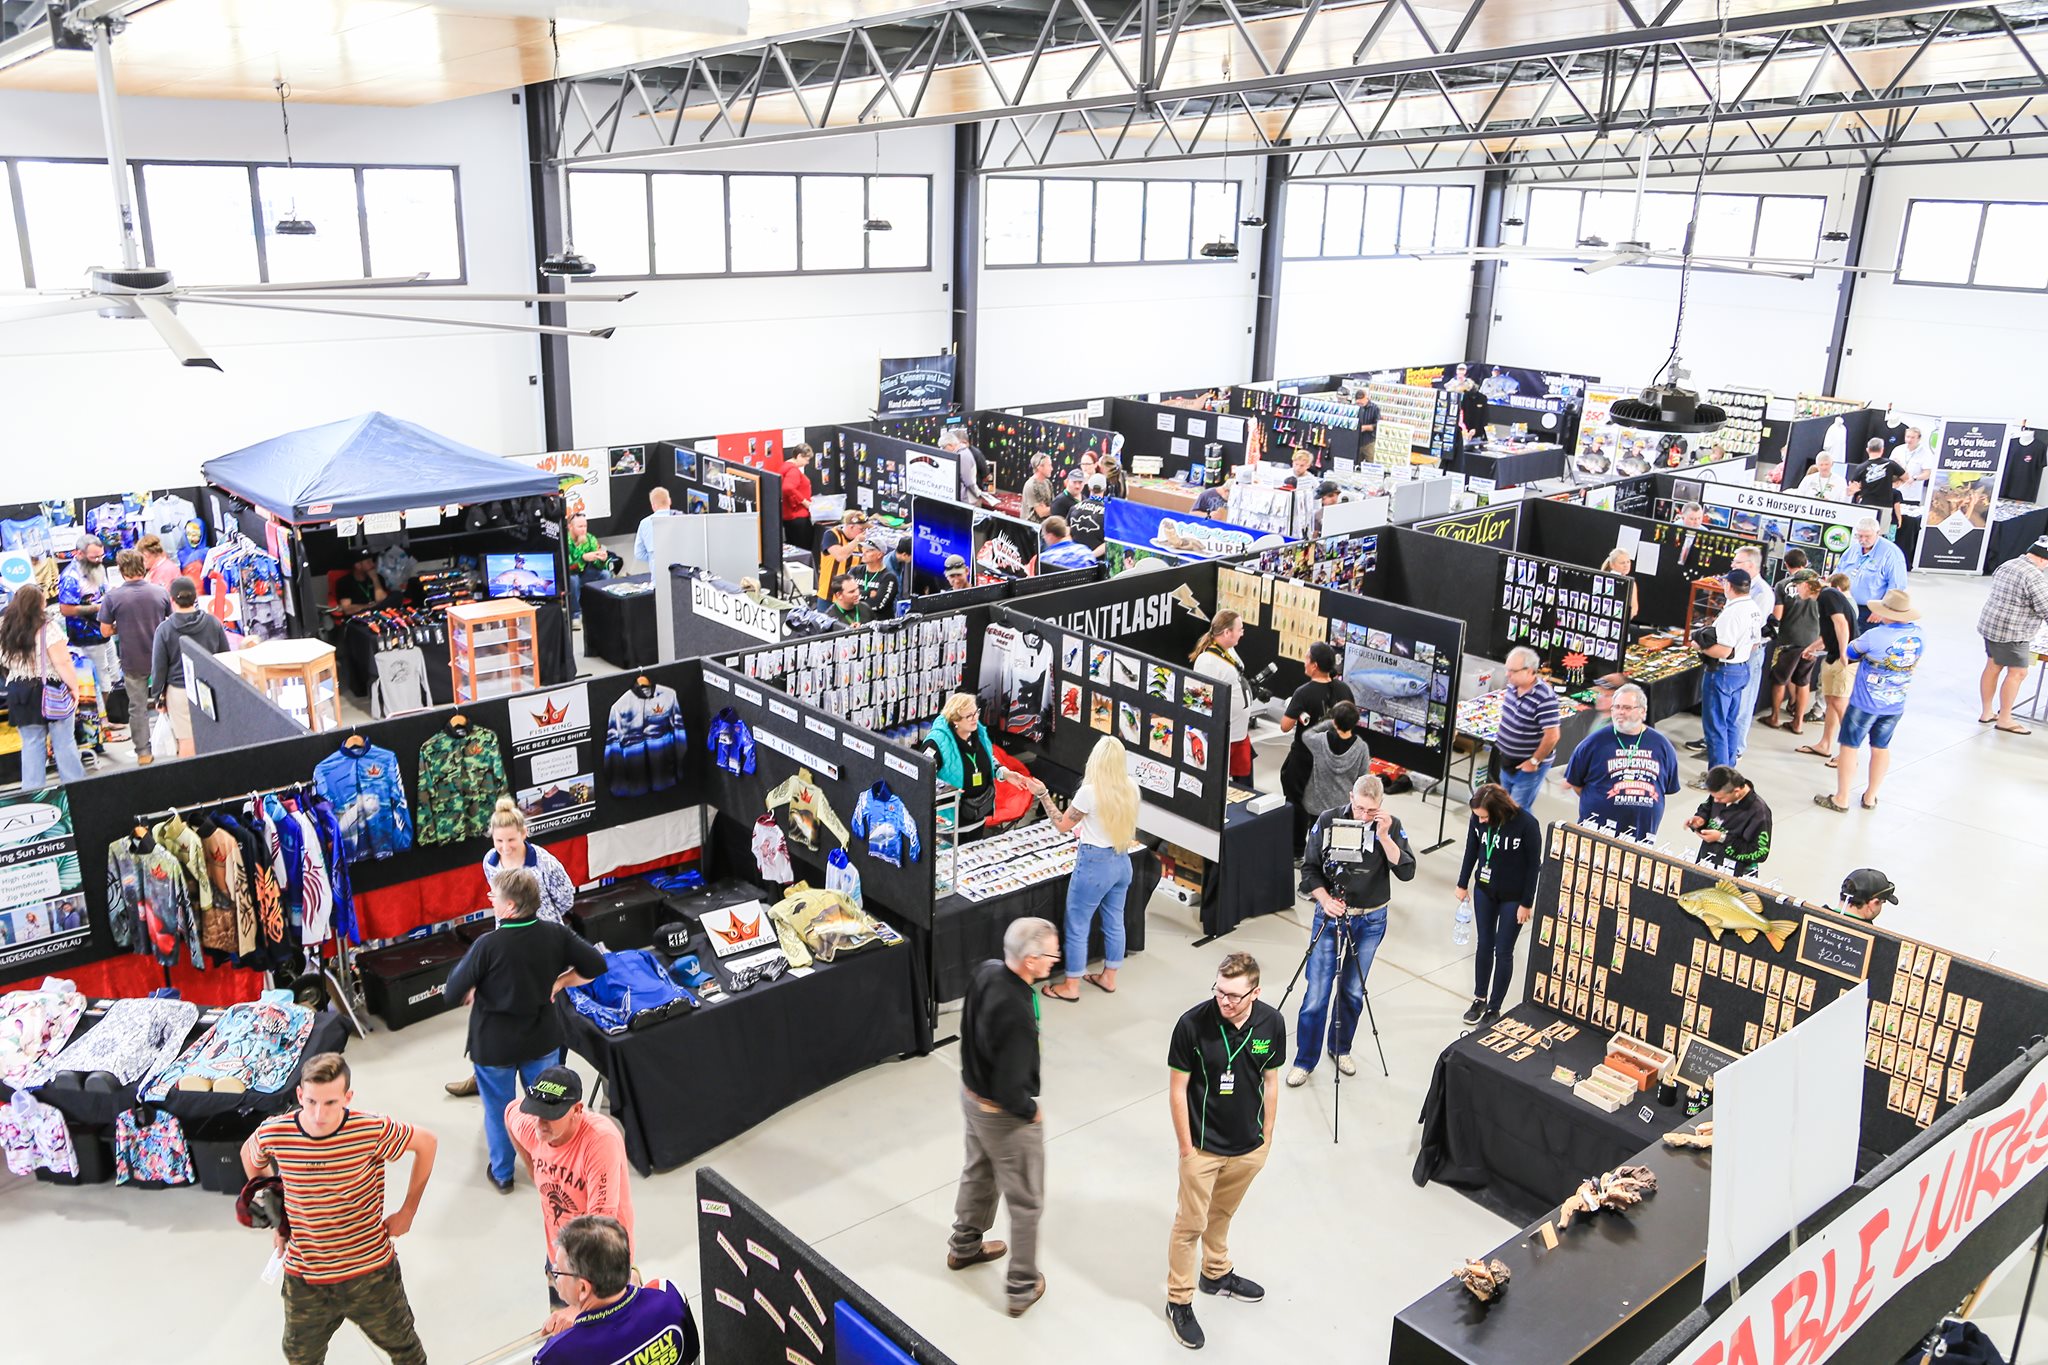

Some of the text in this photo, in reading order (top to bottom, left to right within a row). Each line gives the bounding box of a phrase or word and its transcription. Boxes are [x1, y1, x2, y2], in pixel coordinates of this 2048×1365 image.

[1510, 395, 1536, 408] WATCH
[1547, 400, 1559, 411] ON
[1948, 437, 1997, 447] Do You Want
[1953, 448, 1986, 458] To Catch
[1944, 459, 1992, 469] Bigger Fish?
[1738, 493, 1837, 519] C & S Horsey's Lures
[6, 564, 26, 576] $45
[735, 599, 776, 634] BOXES
[1348, 646, 1398, 667] FREQUENTFLASH
[529, 722, 573, 737] FISH KING
[516, 731, 588, 753] THE BEST SUN SHIRT
[16, 846, 36, 859] Sun
[37, 840, 66, 855] Shirts
[1, 870, 45, 885] High Collar
[20, 886, 46, 898] Pocket
[718, 935, 776, 957] FISH KING
[1818, 947, 1842, 963] $20
